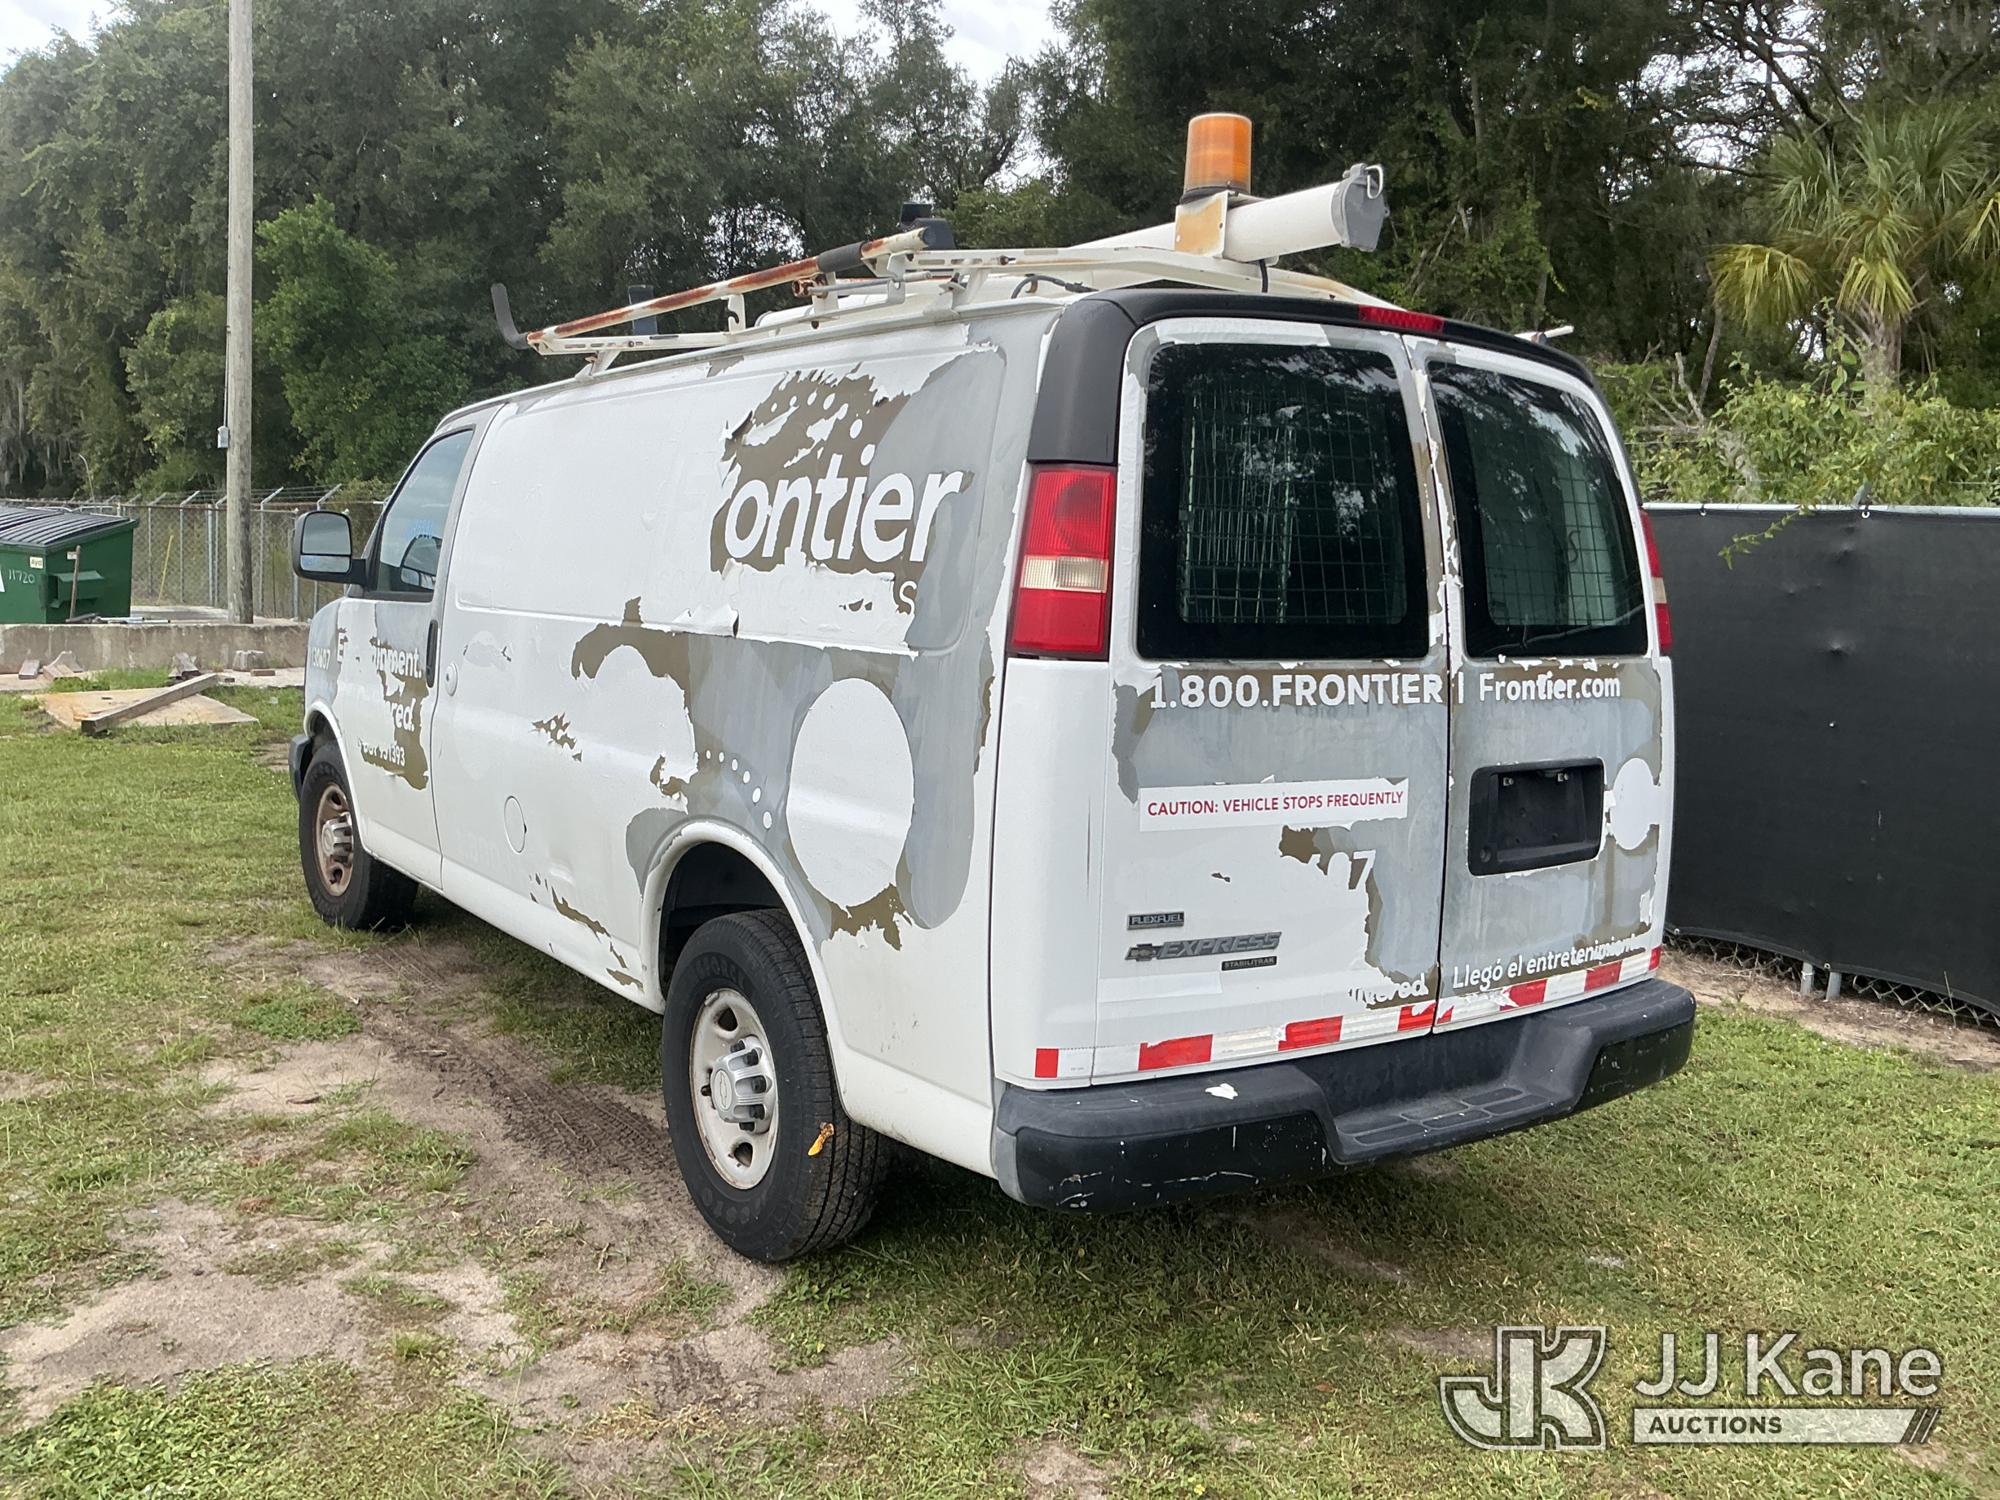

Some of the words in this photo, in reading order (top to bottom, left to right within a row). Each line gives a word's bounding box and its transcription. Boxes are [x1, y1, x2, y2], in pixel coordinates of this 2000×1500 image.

[1150, 674, 1444, 709] 1.800.FRONTIER
[1480, 671, 1621, 701] Frontier.com
[1147, 800, 1218, 817] CAUTION:
[1223, 797, 1279, 813] VEHICLE
[1283, 795, 1323, 811] STOPS
[1327, 791, 1404, 808] FREQUENTLY
[1131, 913, 1183, 925] FLEXFUEL
[1159, 932, 1282, 958] EXPRESS
[1224, 958, 1275, 970] STABILITRAK
[1452, 959, 1504, 992] Llegó
[1507, 955, 1524, 979] el
